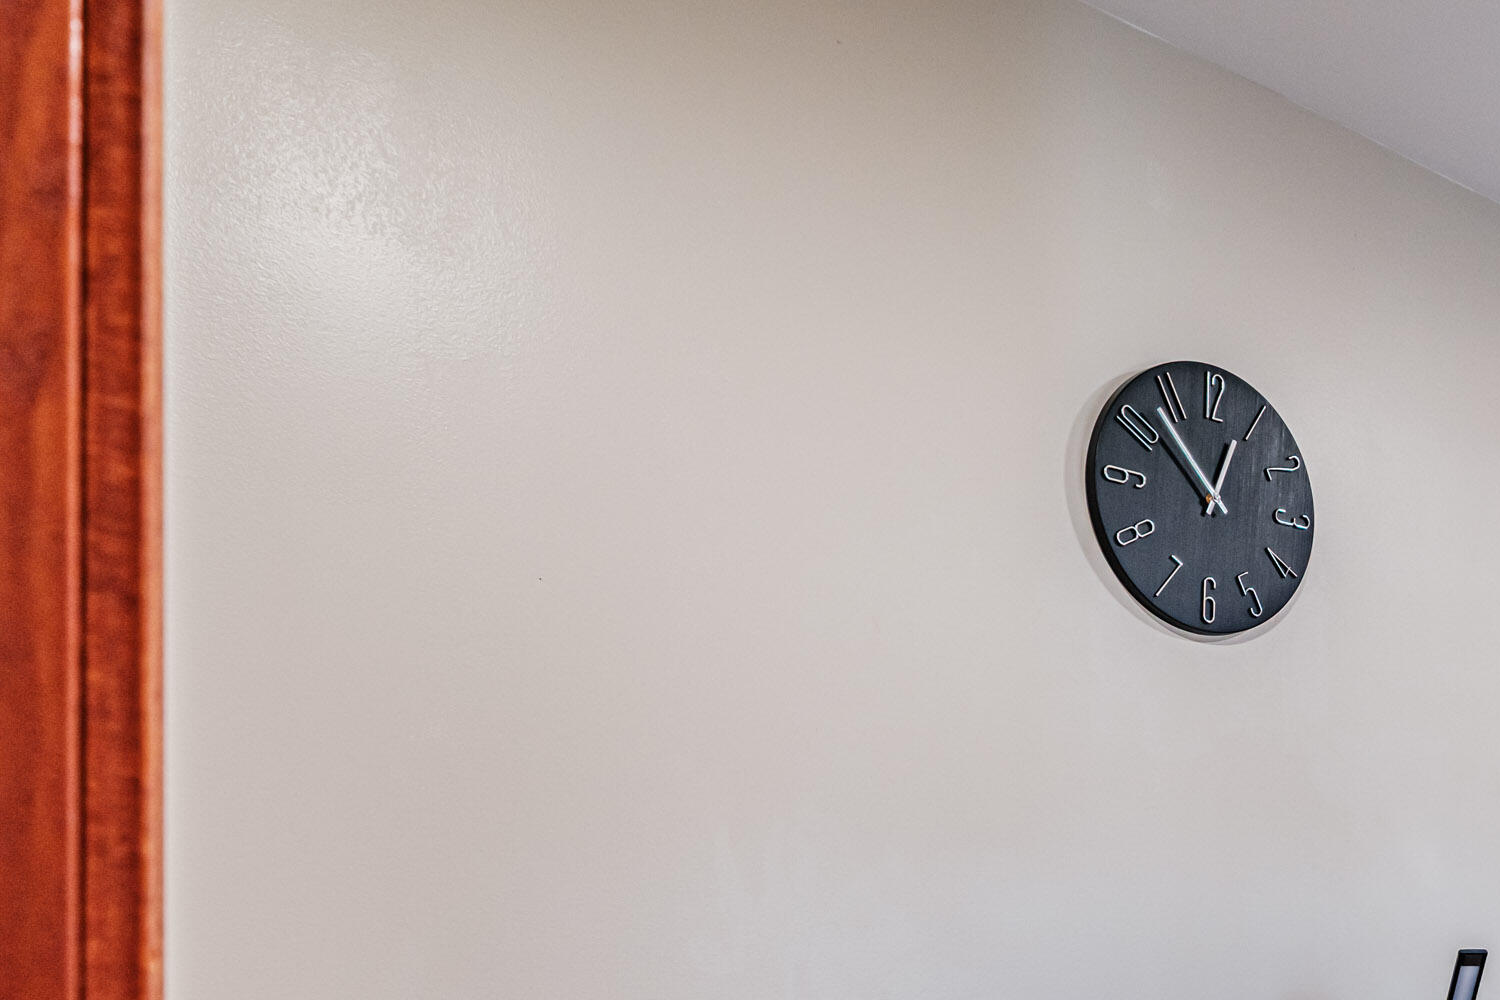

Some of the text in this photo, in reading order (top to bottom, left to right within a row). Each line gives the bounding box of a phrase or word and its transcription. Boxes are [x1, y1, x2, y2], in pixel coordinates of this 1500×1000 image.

[1157, 372, 1187, 423] 11
[1207, 371, 1225, 422] 12
[1116, 404, 1159, 450] 10
[1244, 405, 1267, 441] 1
[1104, 464, 1146, 488] 9
[1266, 455, 1300, 481] 2
[1116, 518, 1155, 546] 8
[1275, 508, 1310, 529] 3
[1155, 554, 1183, 597] 7
[1267, 547, 1297, 578] 4
[1203, 576, 1216, 623] 6
[1238, 571, 1262, 617] 5
